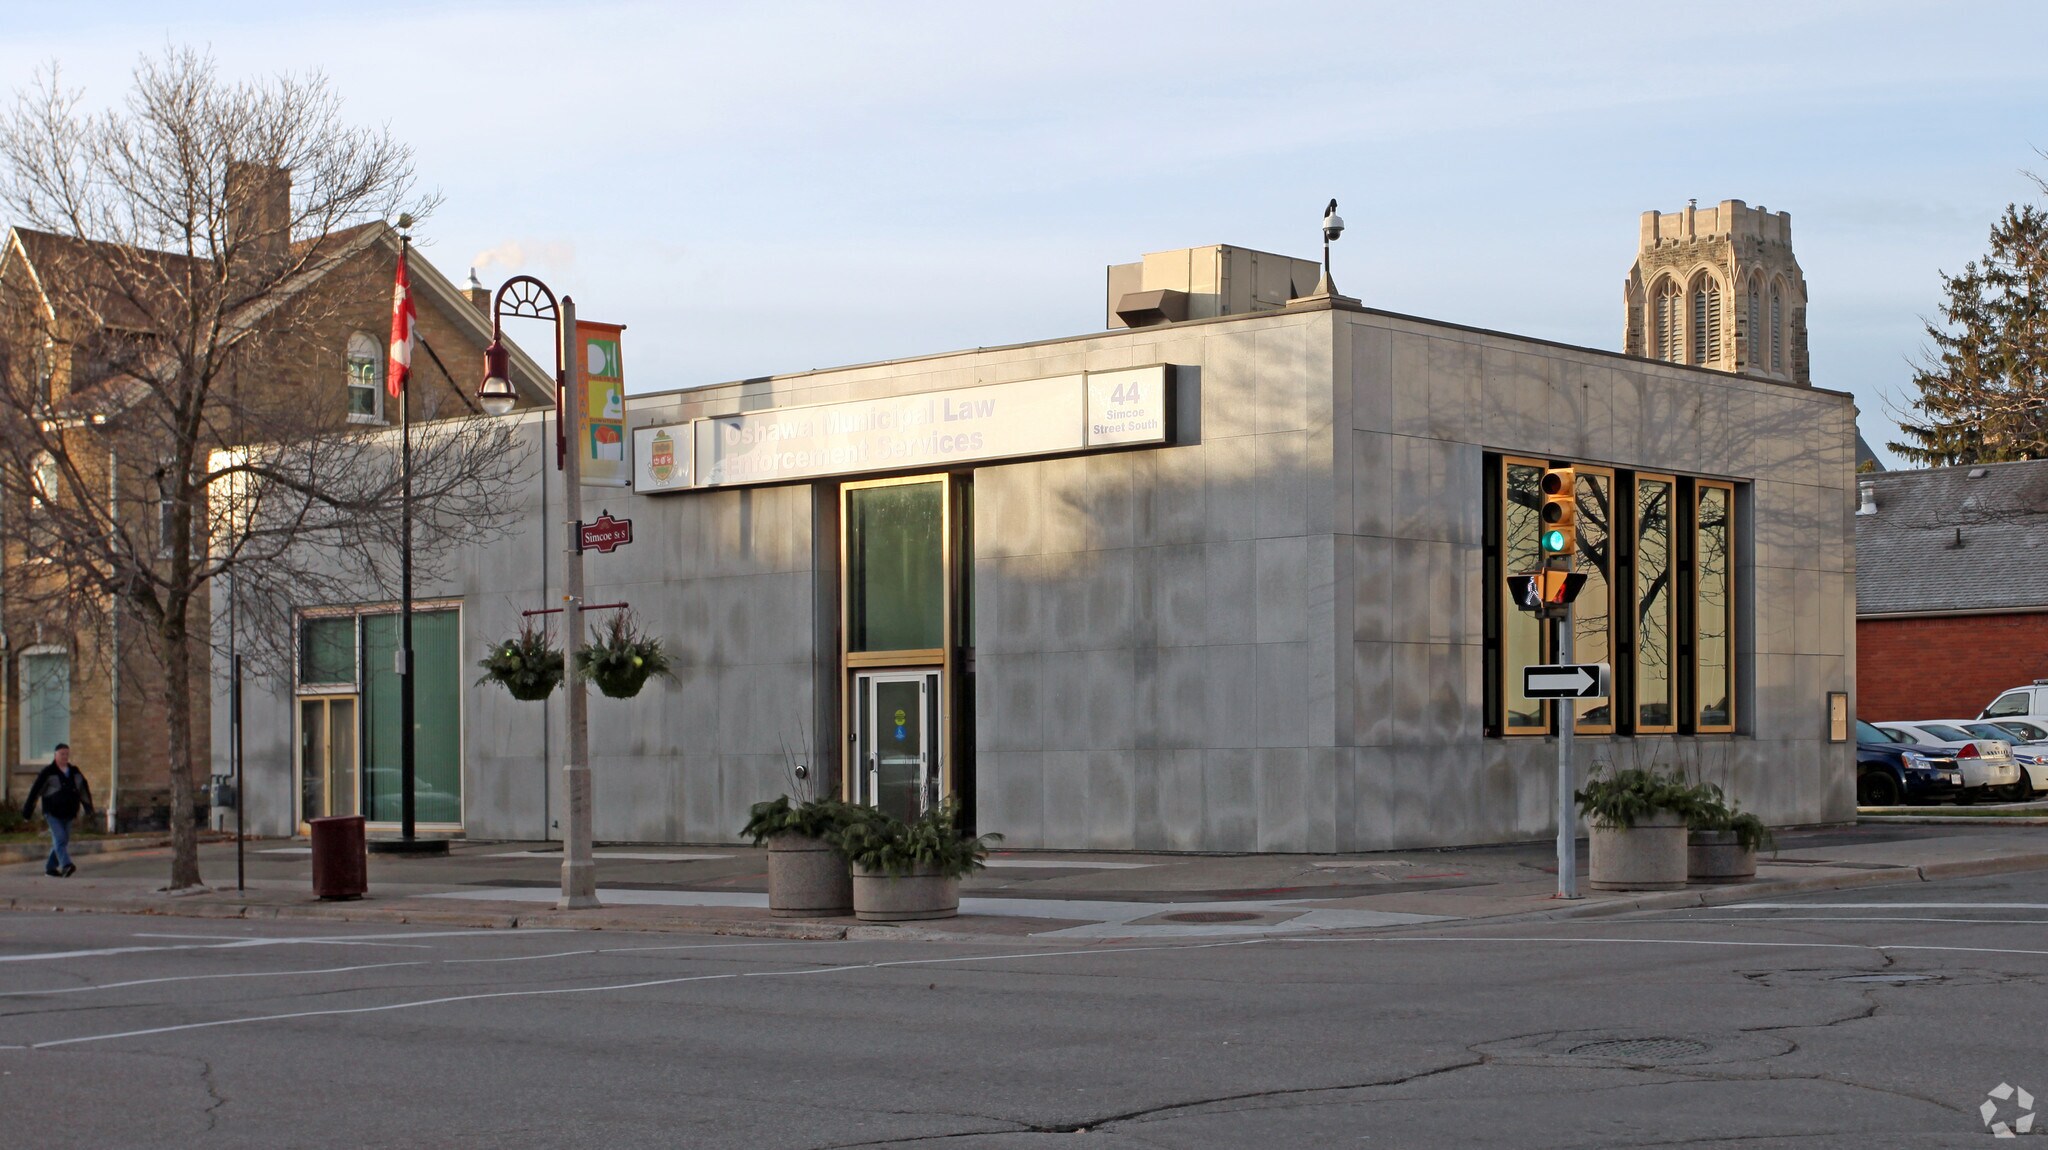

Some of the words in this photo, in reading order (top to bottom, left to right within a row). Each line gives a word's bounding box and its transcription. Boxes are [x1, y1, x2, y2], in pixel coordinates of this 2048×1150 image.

[1110, 381, 1141, 406] 44
[725, 419, 814, 446] Oshawa
[823, 400, 935, 434] Municipal
[943, 397, 996, 422] Law
[1106, 409, 1145, 420] Simcoe
[1093, 422, 1126, 435] Street
[1128, 419, 1158, 431] South
[726, 435, 869, 475] Enforcement
[877, 430, 984, 460] Services
[585, 532, 612, 543] Simcoe
